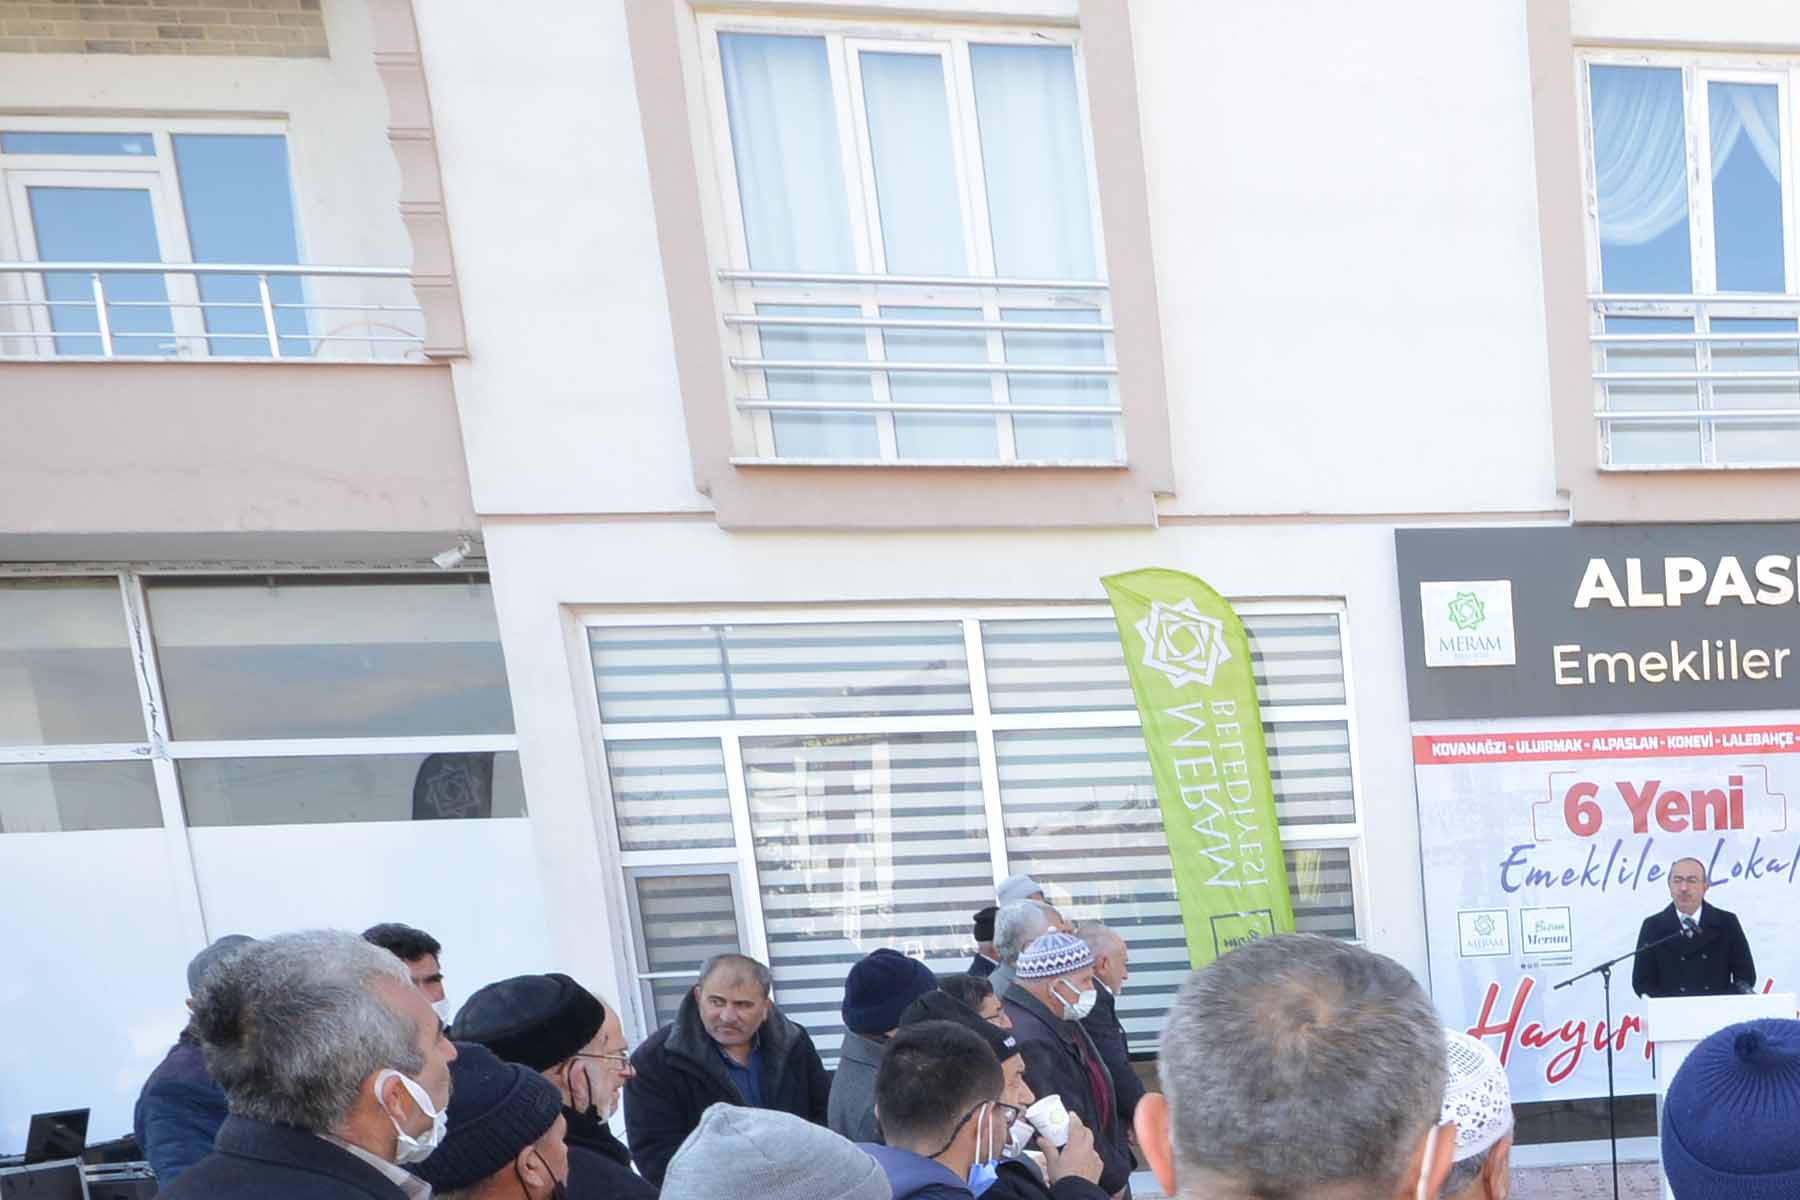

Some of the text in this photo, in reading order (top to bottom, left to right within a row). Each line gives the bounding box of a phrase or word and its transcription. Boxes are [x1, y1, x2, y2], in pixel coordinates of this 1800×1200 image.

[1439, 635, 1503, 652] MERAM
[1552, 638, 1791, 686] Emekliler
[1431, 739, 1507, 757] KOVANAĞZI
[1592, 735, 1659, 751] ALPASLAN
[1667, 731, 1713, 749] KONEVİ
[1722, 731, 1794, 749] LALEBAHÇE
[1563, 775, 1745, 838] 6 Yeni
[1499, 837, 1668, 894] Emeklile
[1466, 976, 1653, 1085] Hayır
